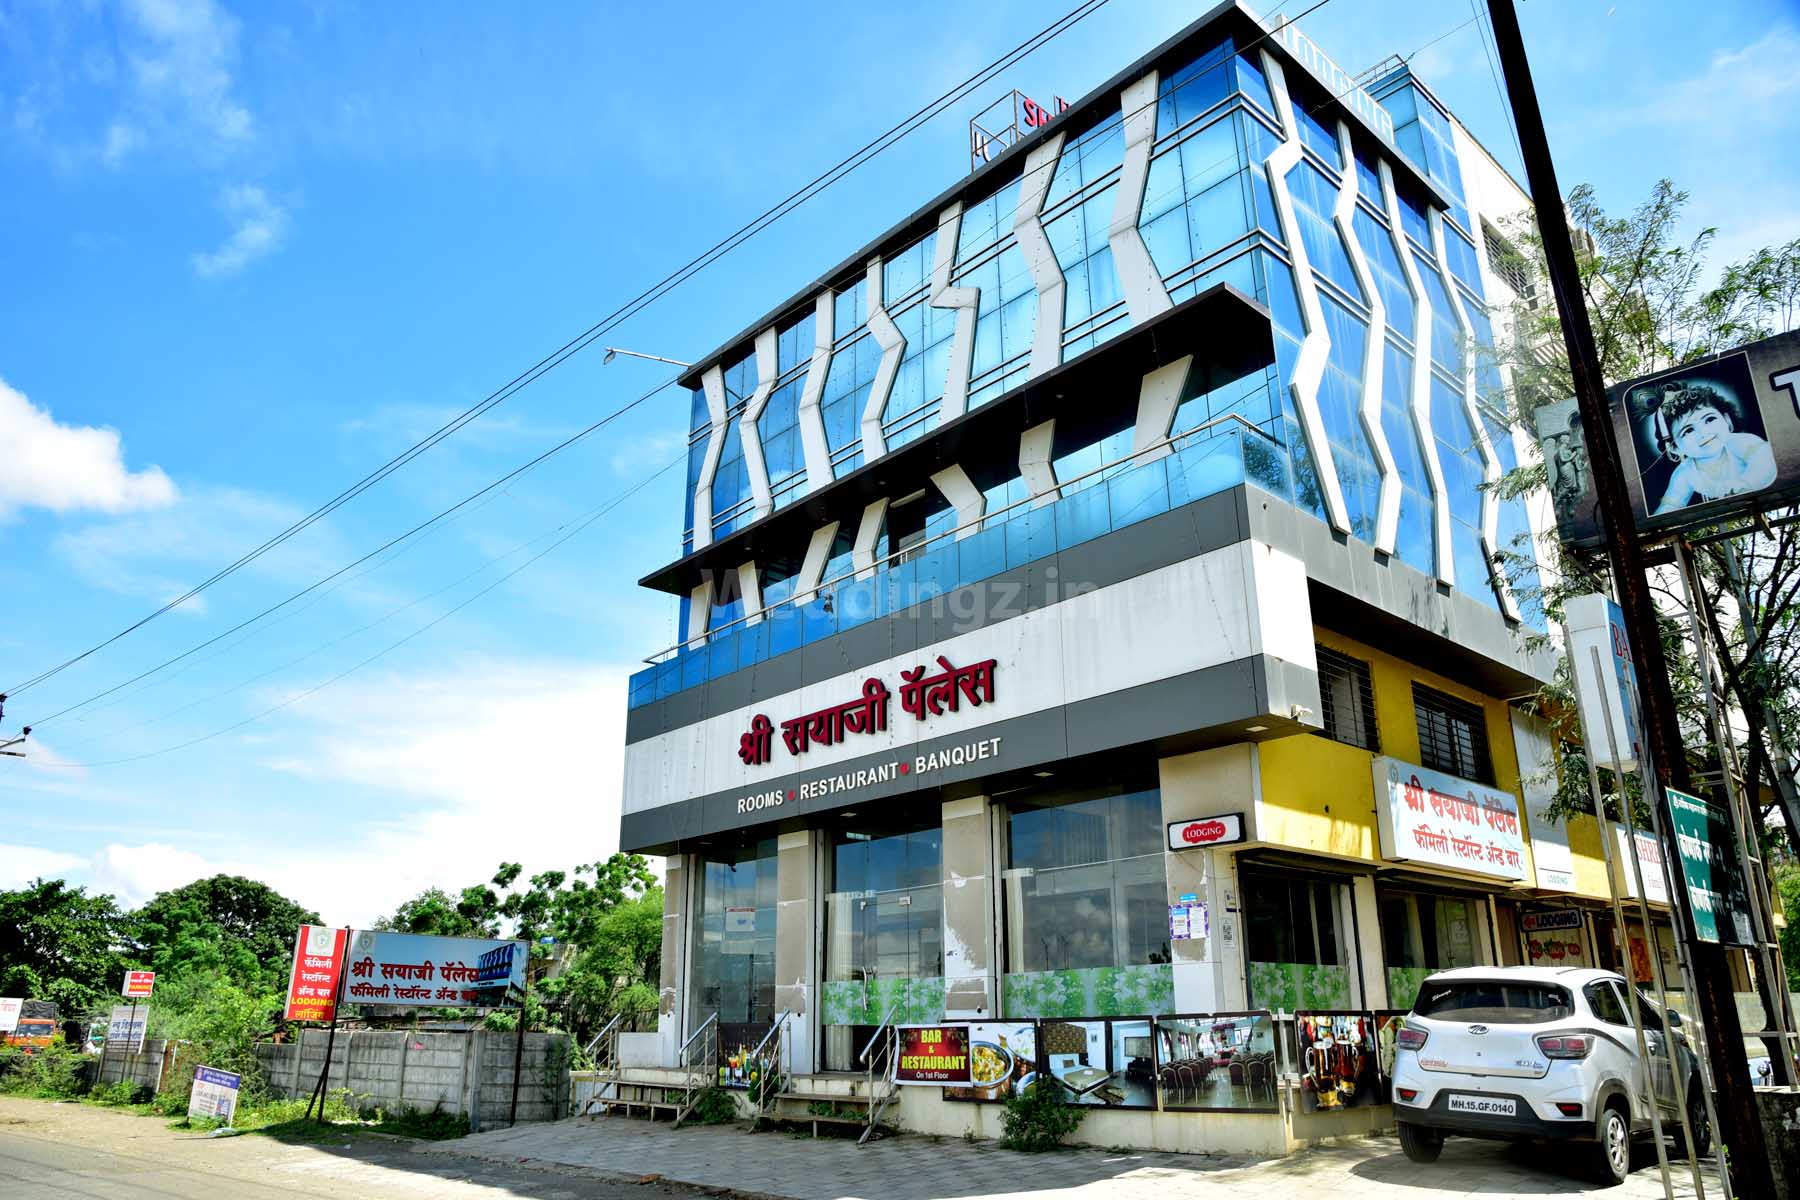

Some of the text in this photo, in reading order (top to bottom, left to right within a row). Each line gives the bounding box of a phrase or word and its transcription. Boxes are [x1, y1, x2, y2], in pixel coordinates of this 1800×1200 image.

[738, 655, 997, 765] श्री सयाजी पॅलेस
[737, 737, 1002, 814] ROOMS RESTAURANT BANQUET
[1404, 774, 1425, 813] श्री
[1186, 826, 1222, 839] LODGING
[1536, 911, 1579, 928] LODGING
[352, 956, 480, 982] श्री सयाजी पॅलेस
[350, 982, 390, 999] फॅमिली
[291, 998, 334, 1007] LODGING
[921, 1029, 942, 1044] BAR
[928, 1045, 935, 1054] &
[902, 1055, 967, 1070] RESTAURANT
[925, 1071, 933, 1079] 1st
[934, 1071, 949, 1079] Floor
[1451, 1099, 1514, 1114] MH.15.GF.0140
